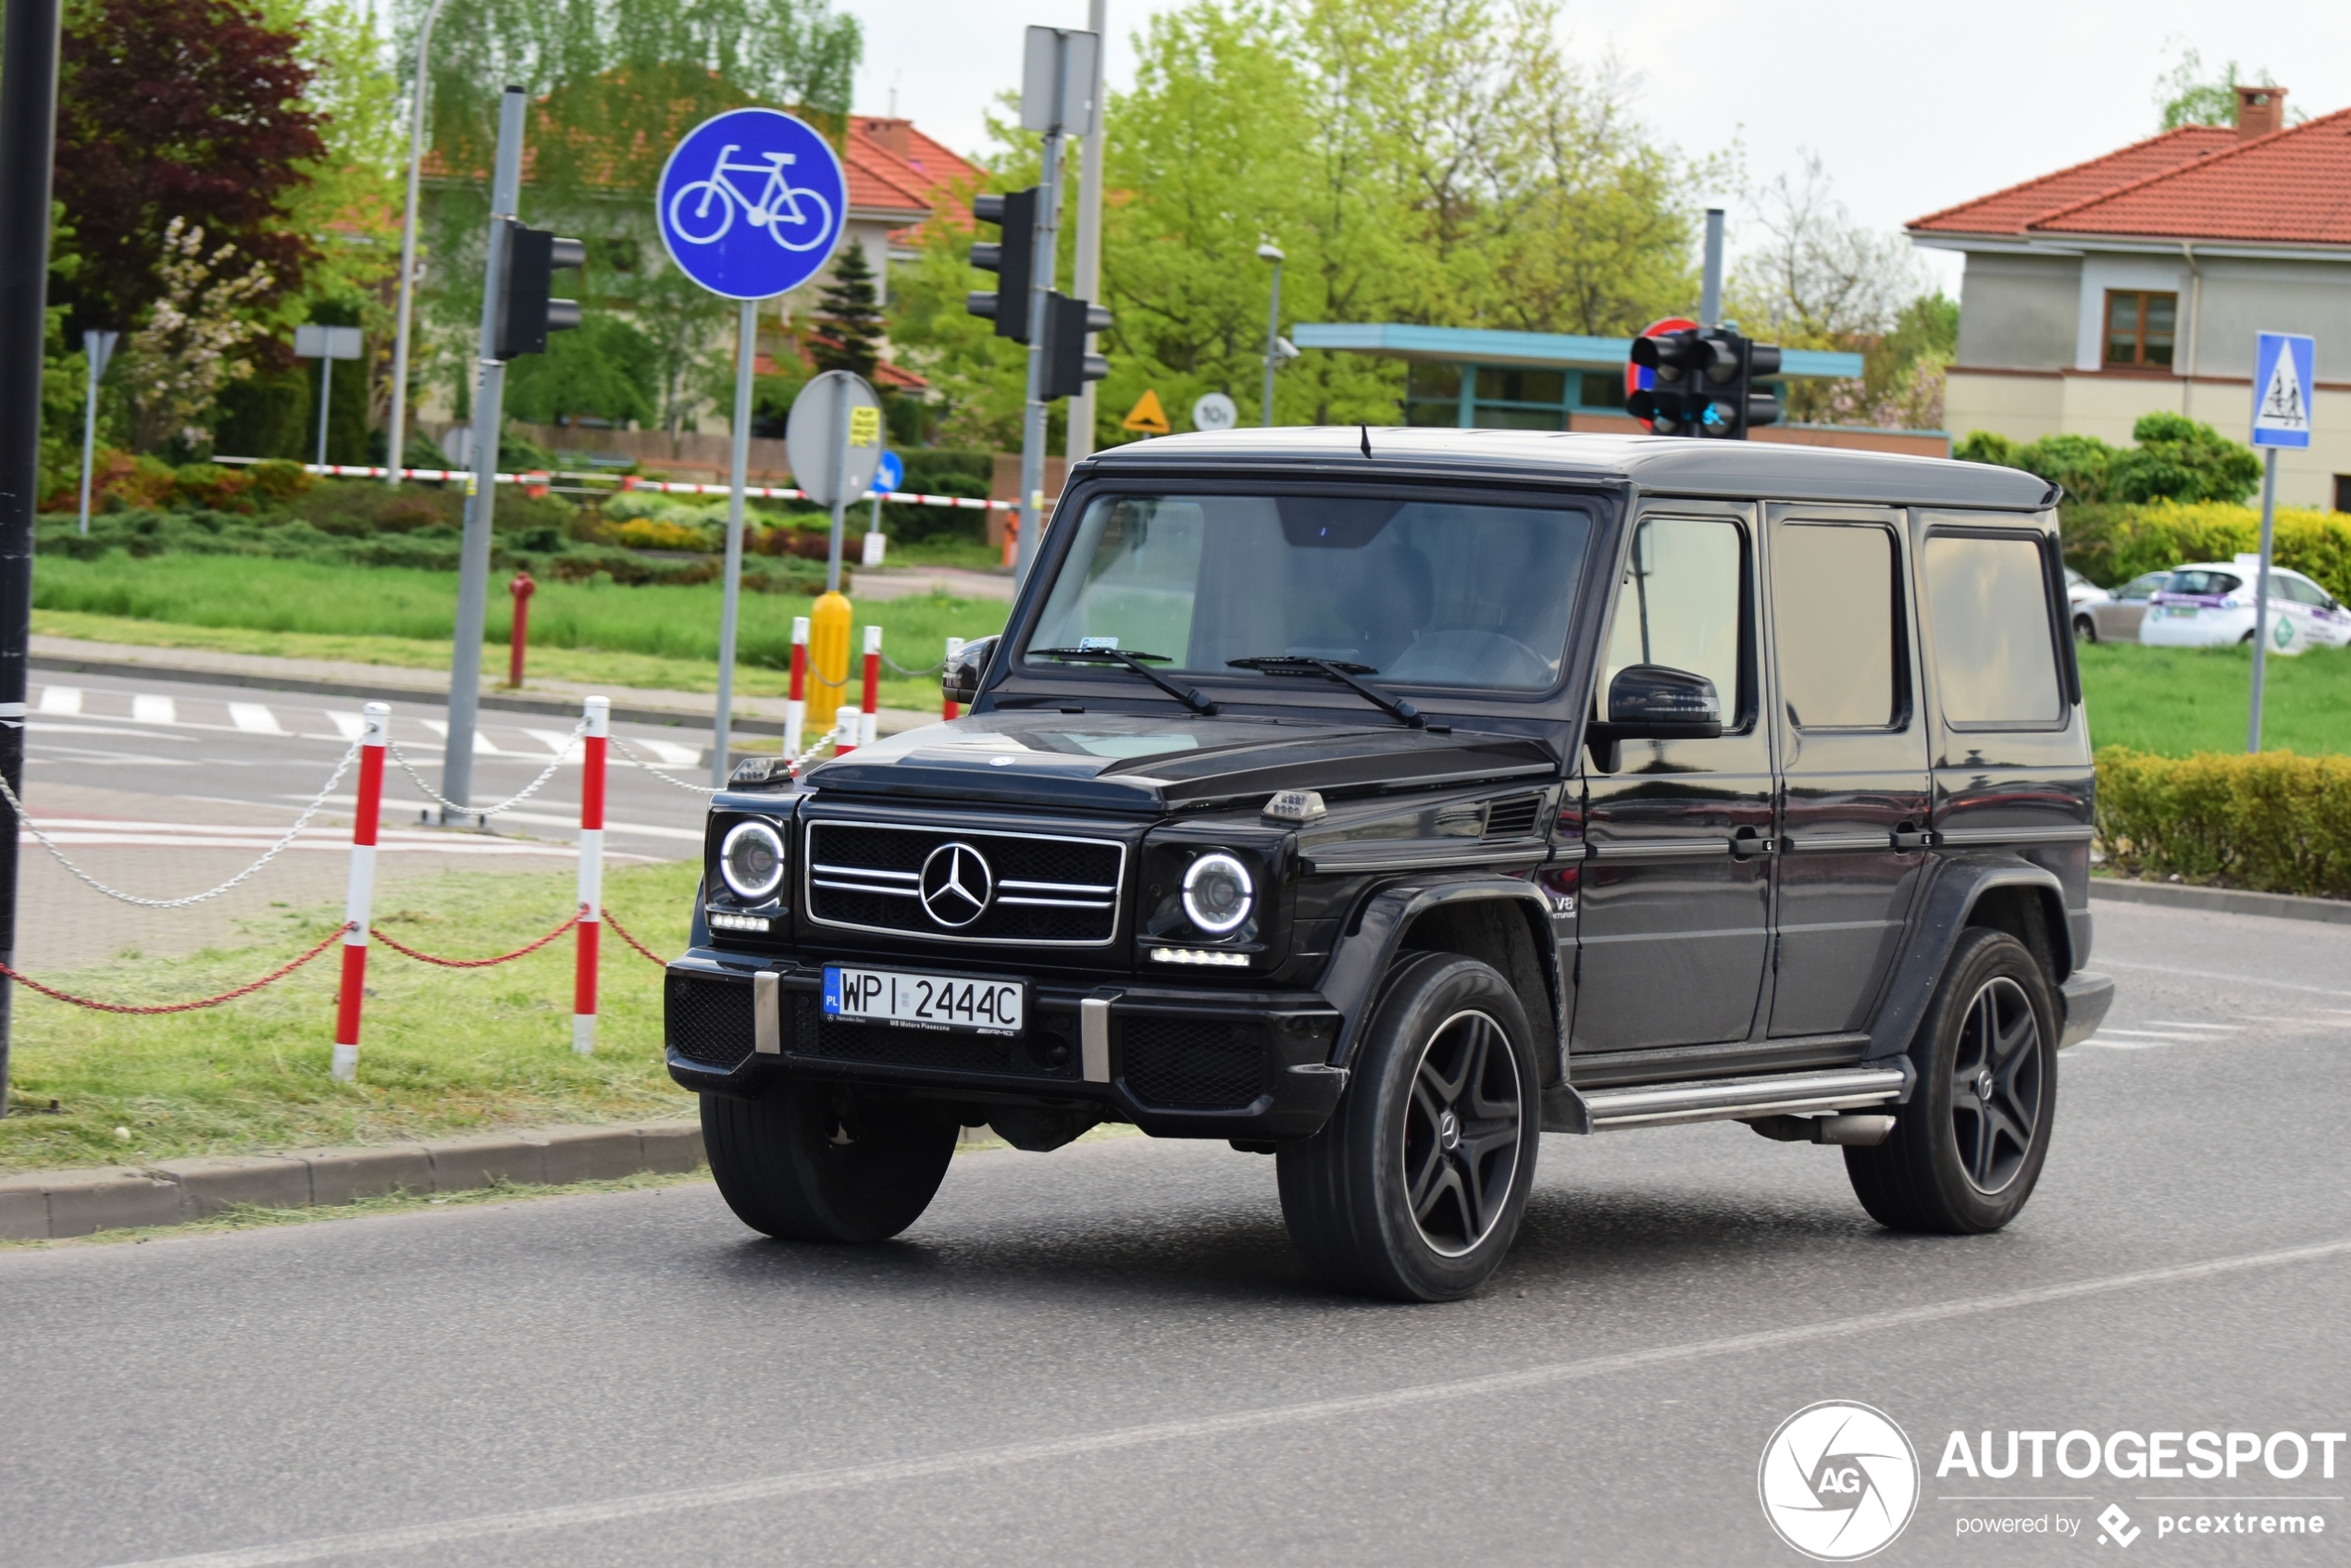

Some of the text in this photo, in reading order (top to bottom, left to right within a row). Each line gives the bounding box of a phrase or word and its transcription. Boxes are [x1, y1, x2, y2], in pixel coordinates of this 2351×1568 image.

[1555, 897, 1574, 911] V8
[826, 995, 839, 1007] PL
[842, 973, 1016, 1025] WPI 2444C
[889, 1019, 951, 1032] MB Motors Piaseczno
